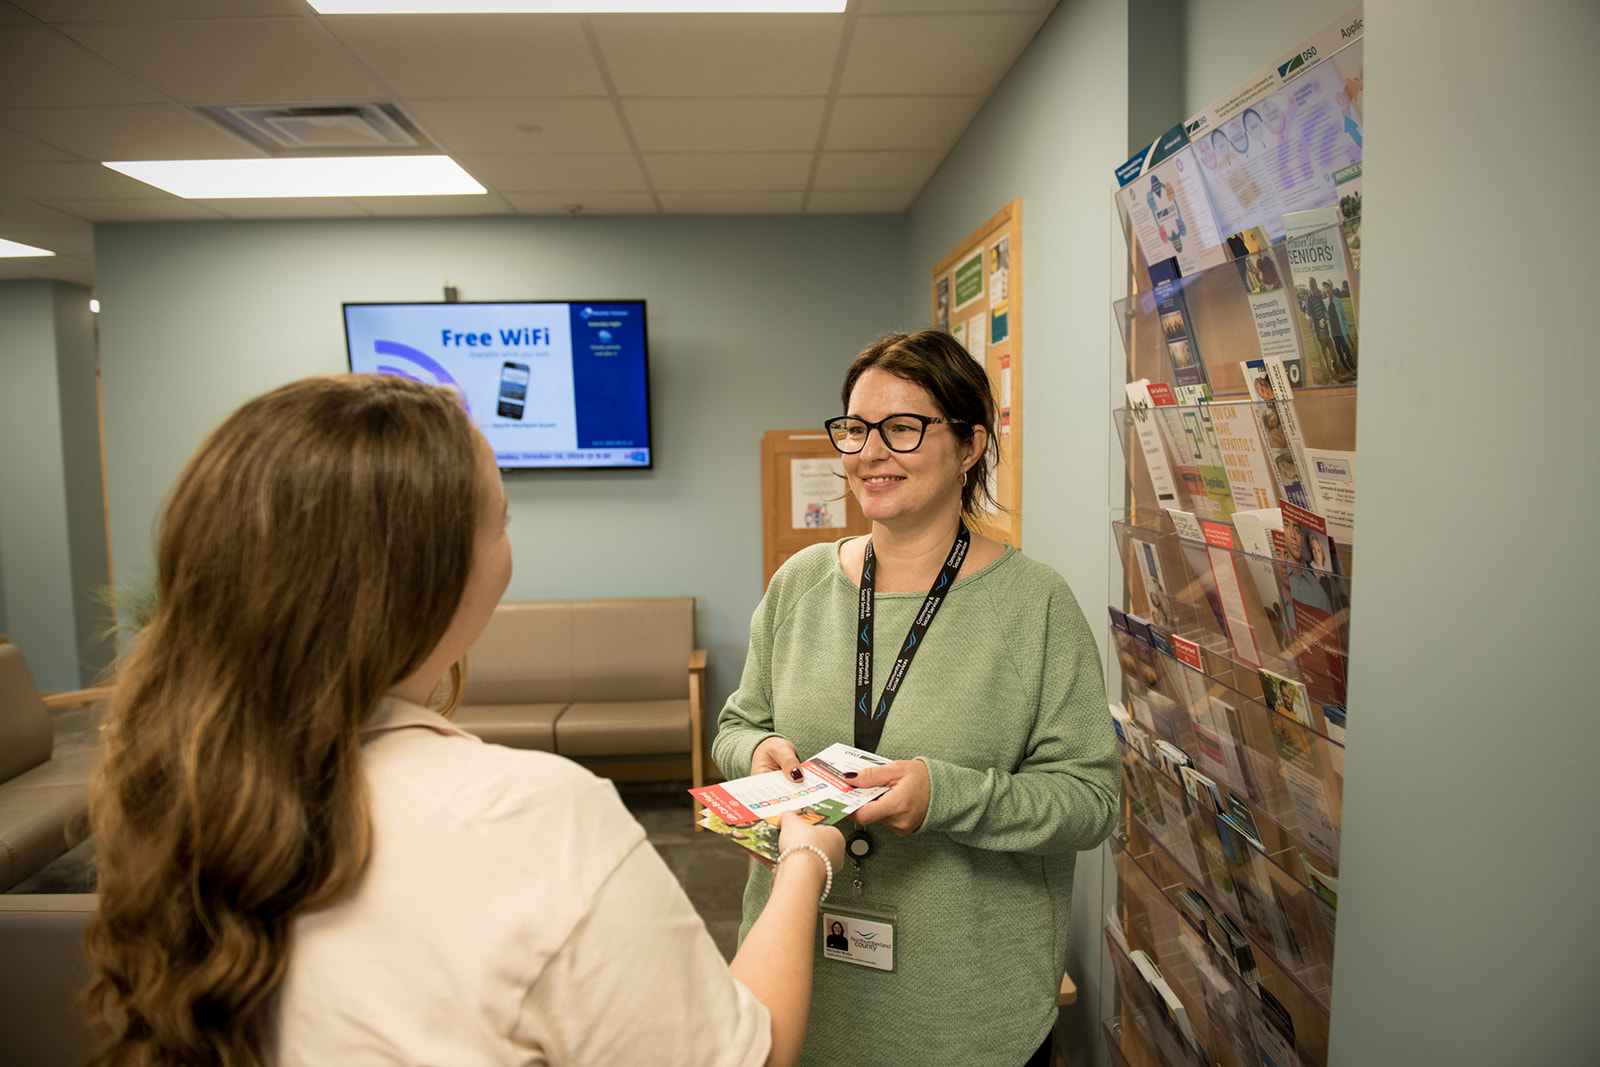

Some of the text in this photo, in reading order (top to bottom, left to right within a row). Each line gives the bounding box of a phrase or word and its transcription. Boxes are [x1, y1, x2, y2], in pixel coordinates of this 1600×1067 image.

[1302, 46, 1318, 61] DSO
[1288, 245, 1334, 265] SENIORS'
[1252, 299, 1279, 311] Community
[1255, 308, 1286, 319] Paramedicine
[441, 327, 550, 347] Free WiFi
[1260, 327, 1291, 338] Care program
[1210, 406, 1237, 420] YOU CAN
[1214, 422, 1232, 436] HAVE
[1218, 438, 1256, 452] HEPATITIS C
[1223, 454, 1250, 468] AND NOT
[1227, 469, 1255, 484] KNOW IT
[947, 545, 961, 567] Community
[952, 555, 962, 569] Social
[916, 601, 932, 625] Community
[921, 597, 940, 627] Social Services
[886, 664, 901, 691] Community
[890, 658, 909, 692] Social Services
[698, 791, 713, 802] Hard
[718, 805, 729, 815] Can
[850, 936, 891, 949] Northumberland
